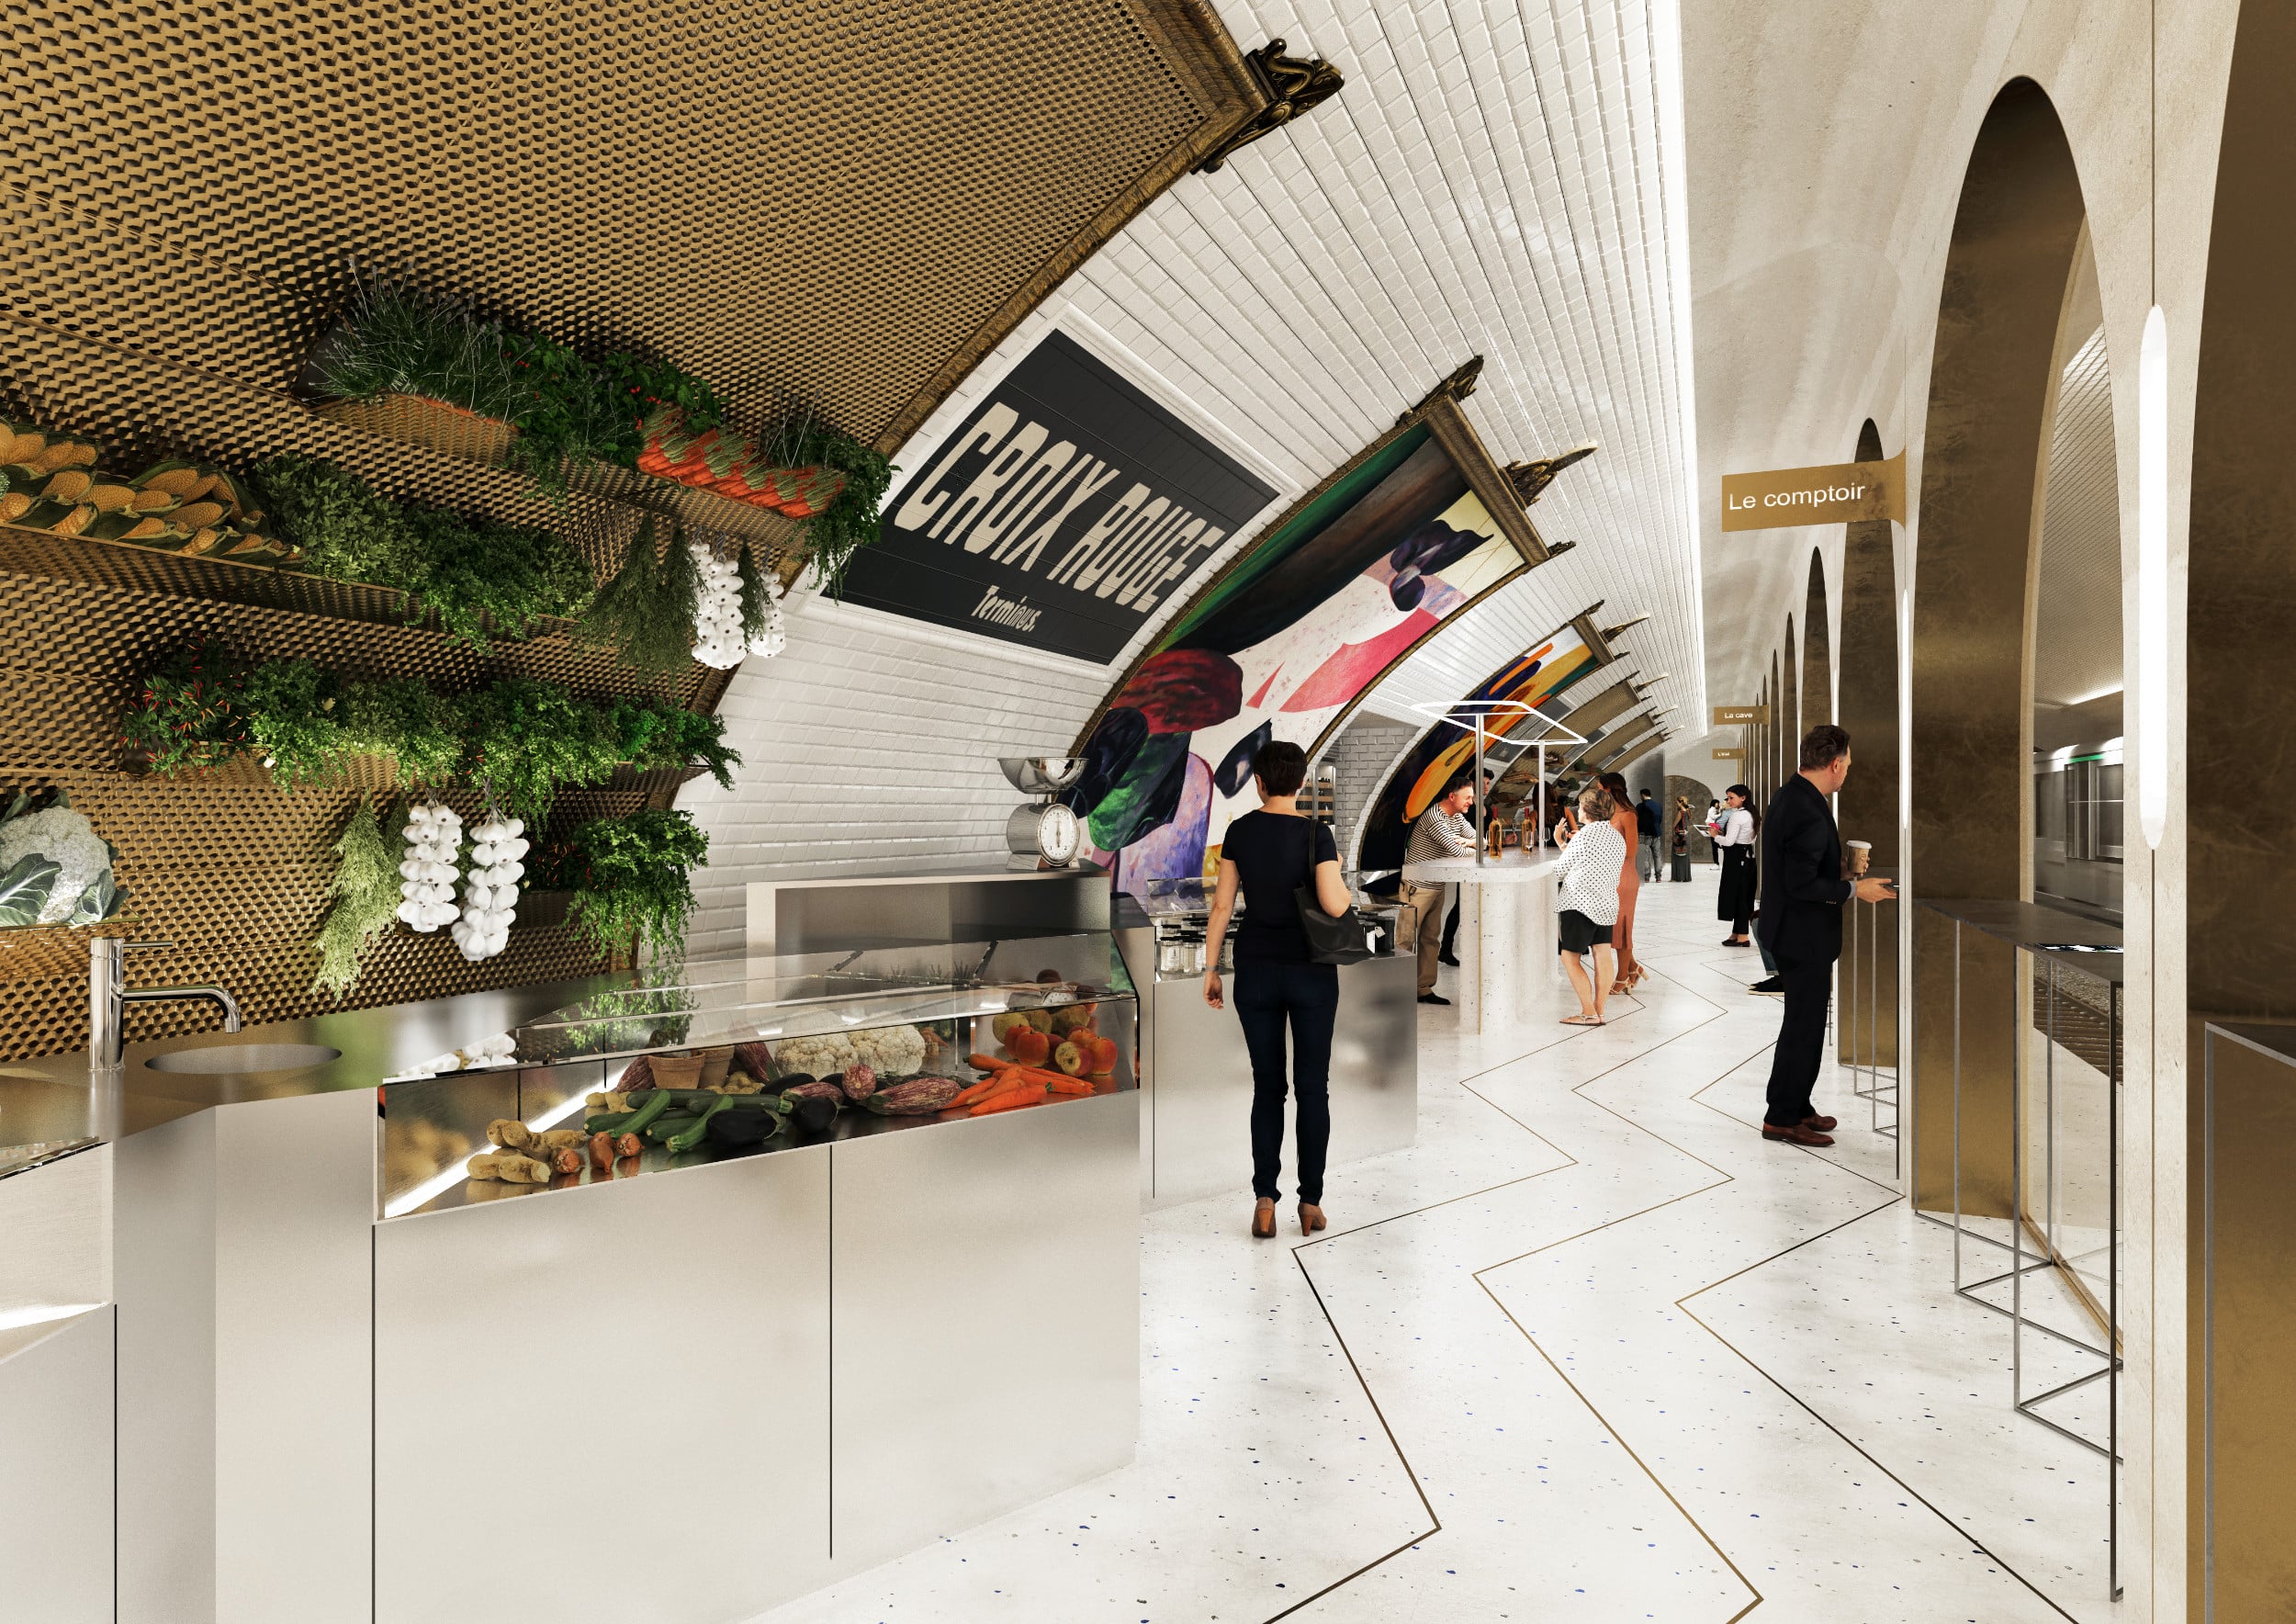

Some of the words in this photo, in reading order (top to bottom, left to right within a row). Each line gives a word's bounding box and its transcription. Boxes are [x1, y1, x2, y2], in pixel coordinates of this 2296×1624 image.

[895, 401, 1120, 573] CROIX
[1046, 482, 1225, 613] ROUGE
[1729, 493, 1756, 511] Le
[1763, 482, 1865, 507] comptoir
